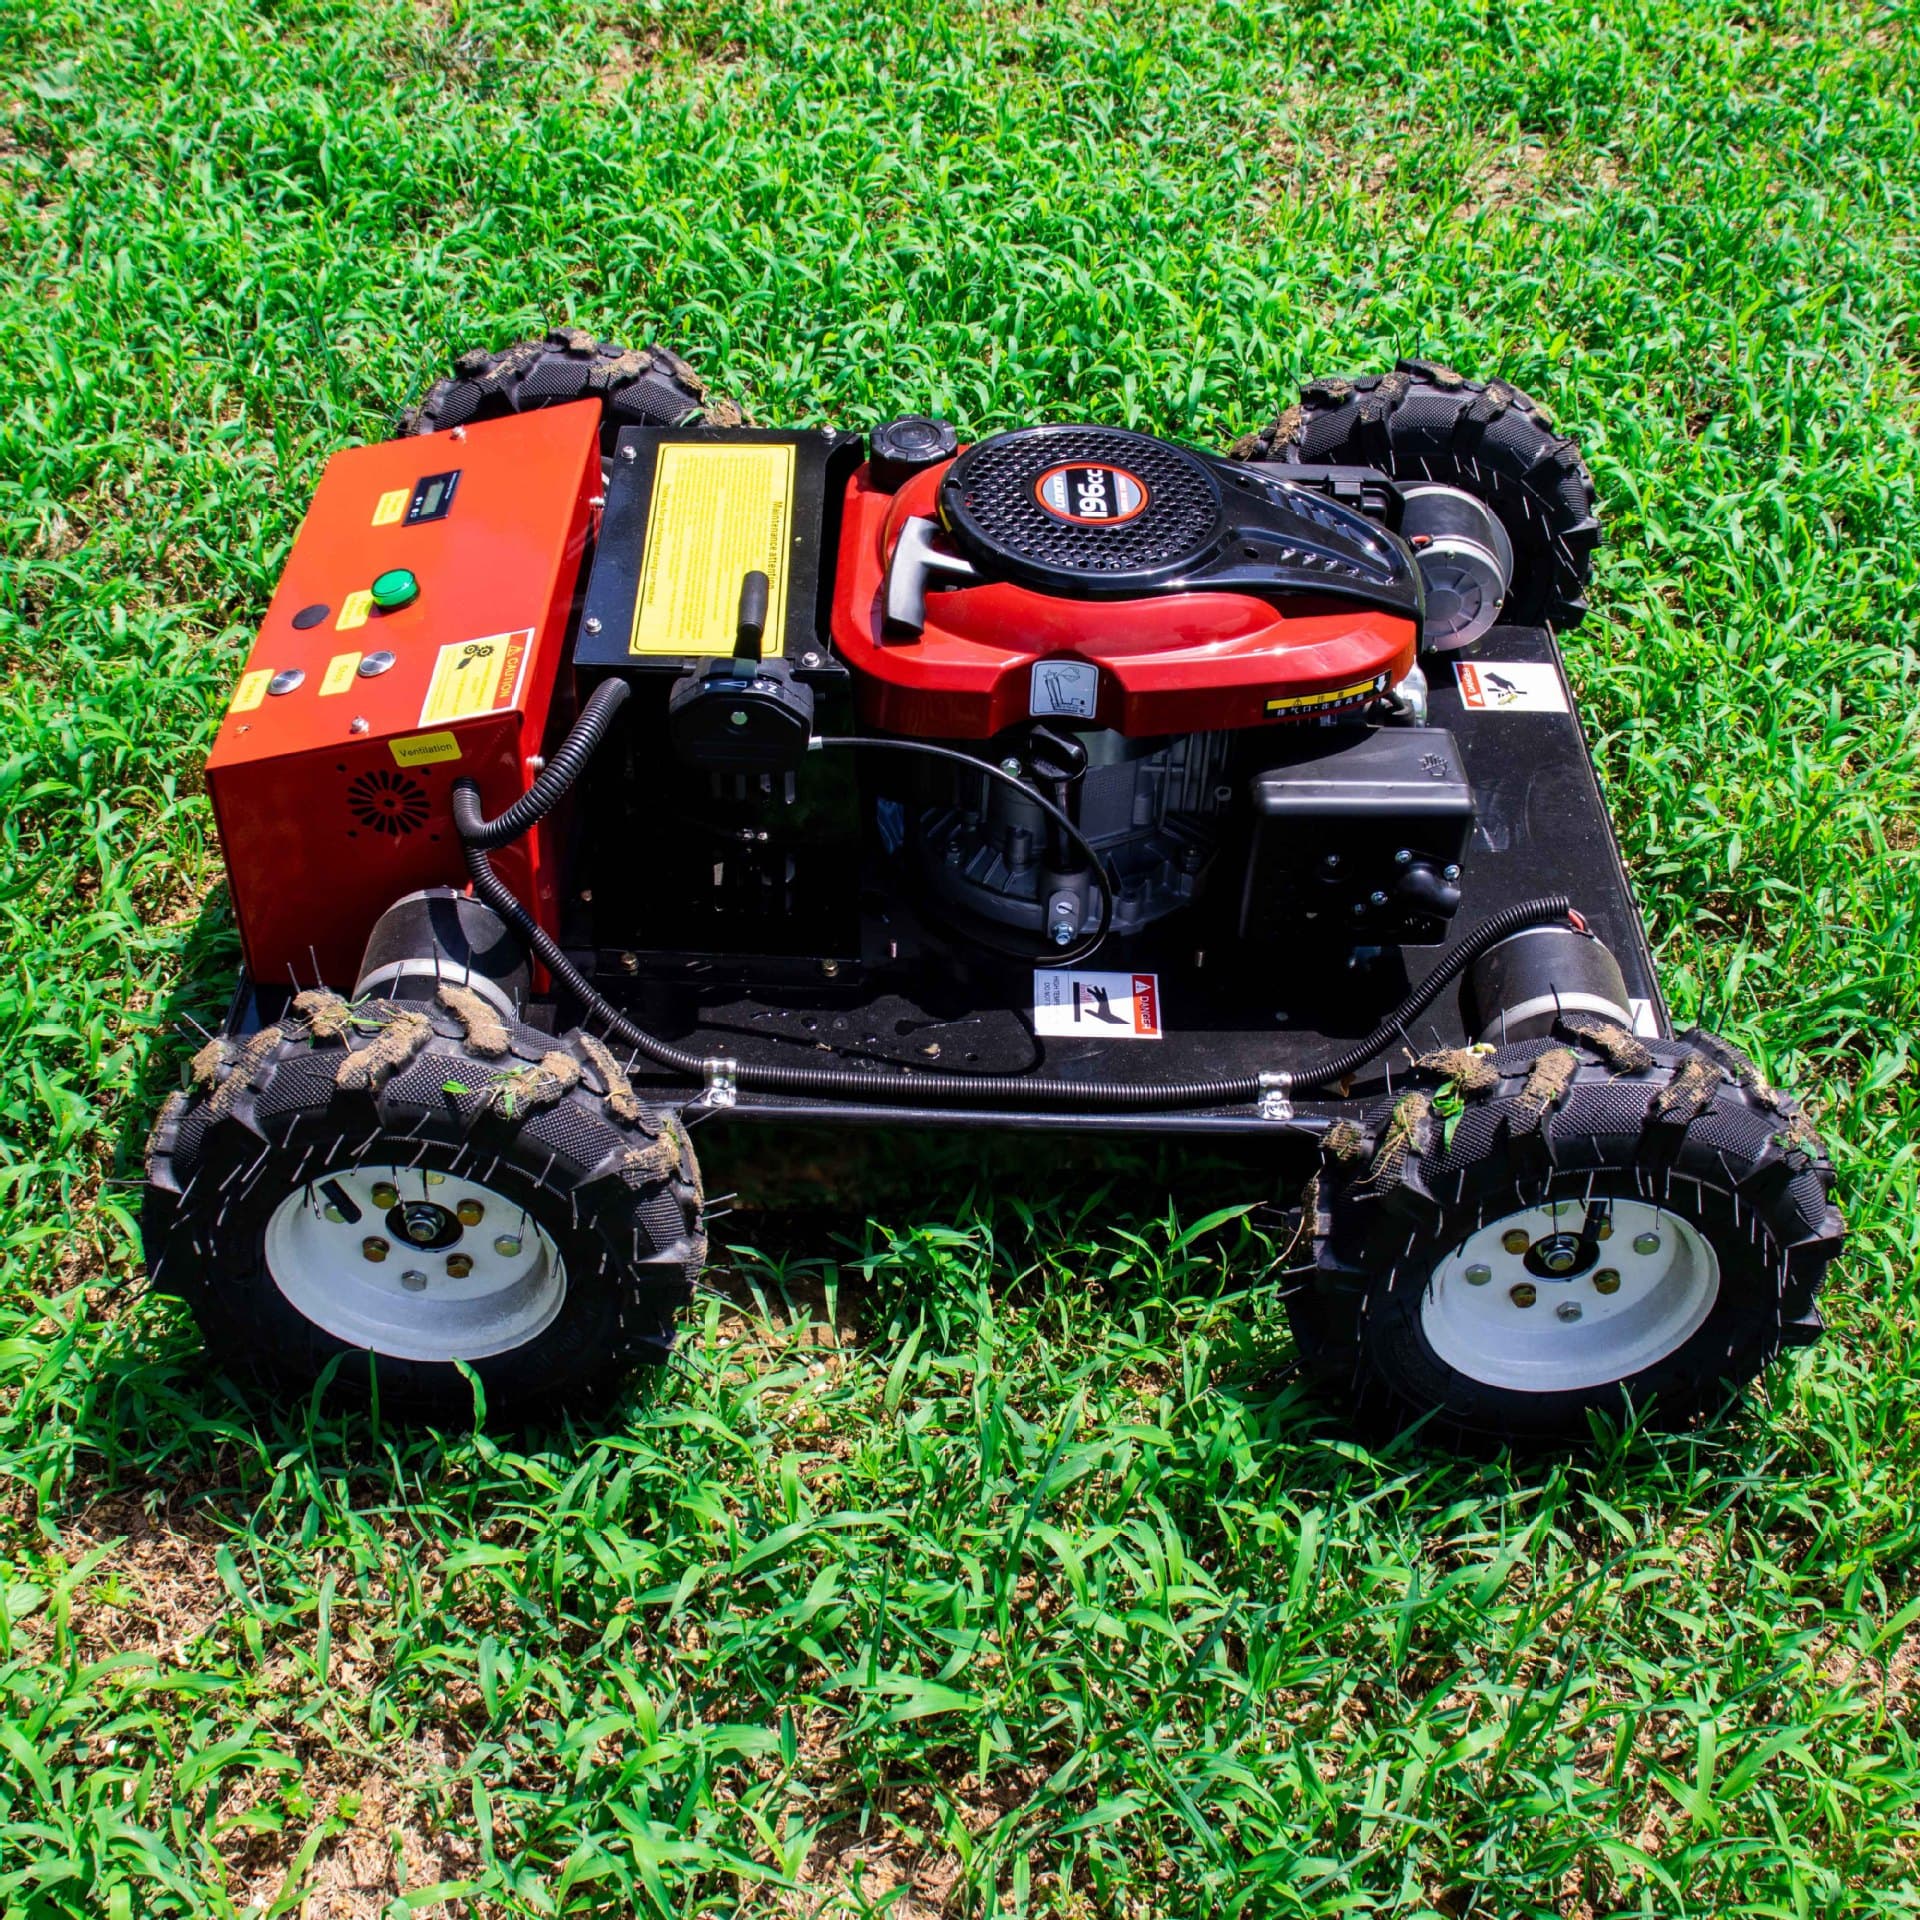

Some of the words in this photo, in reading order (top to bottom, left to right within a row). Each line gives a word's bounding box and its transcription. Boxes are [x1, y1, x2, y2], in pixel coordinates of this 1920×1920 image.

[1077, 469, 1108, 517] 196cc
[770, 501, 783, 549] Maintenance
[499, 658, 519, 698] CAUTION
[399, 743, 453, 757] Ventilation
[1140, 996, 1151, 1030] DANGER
